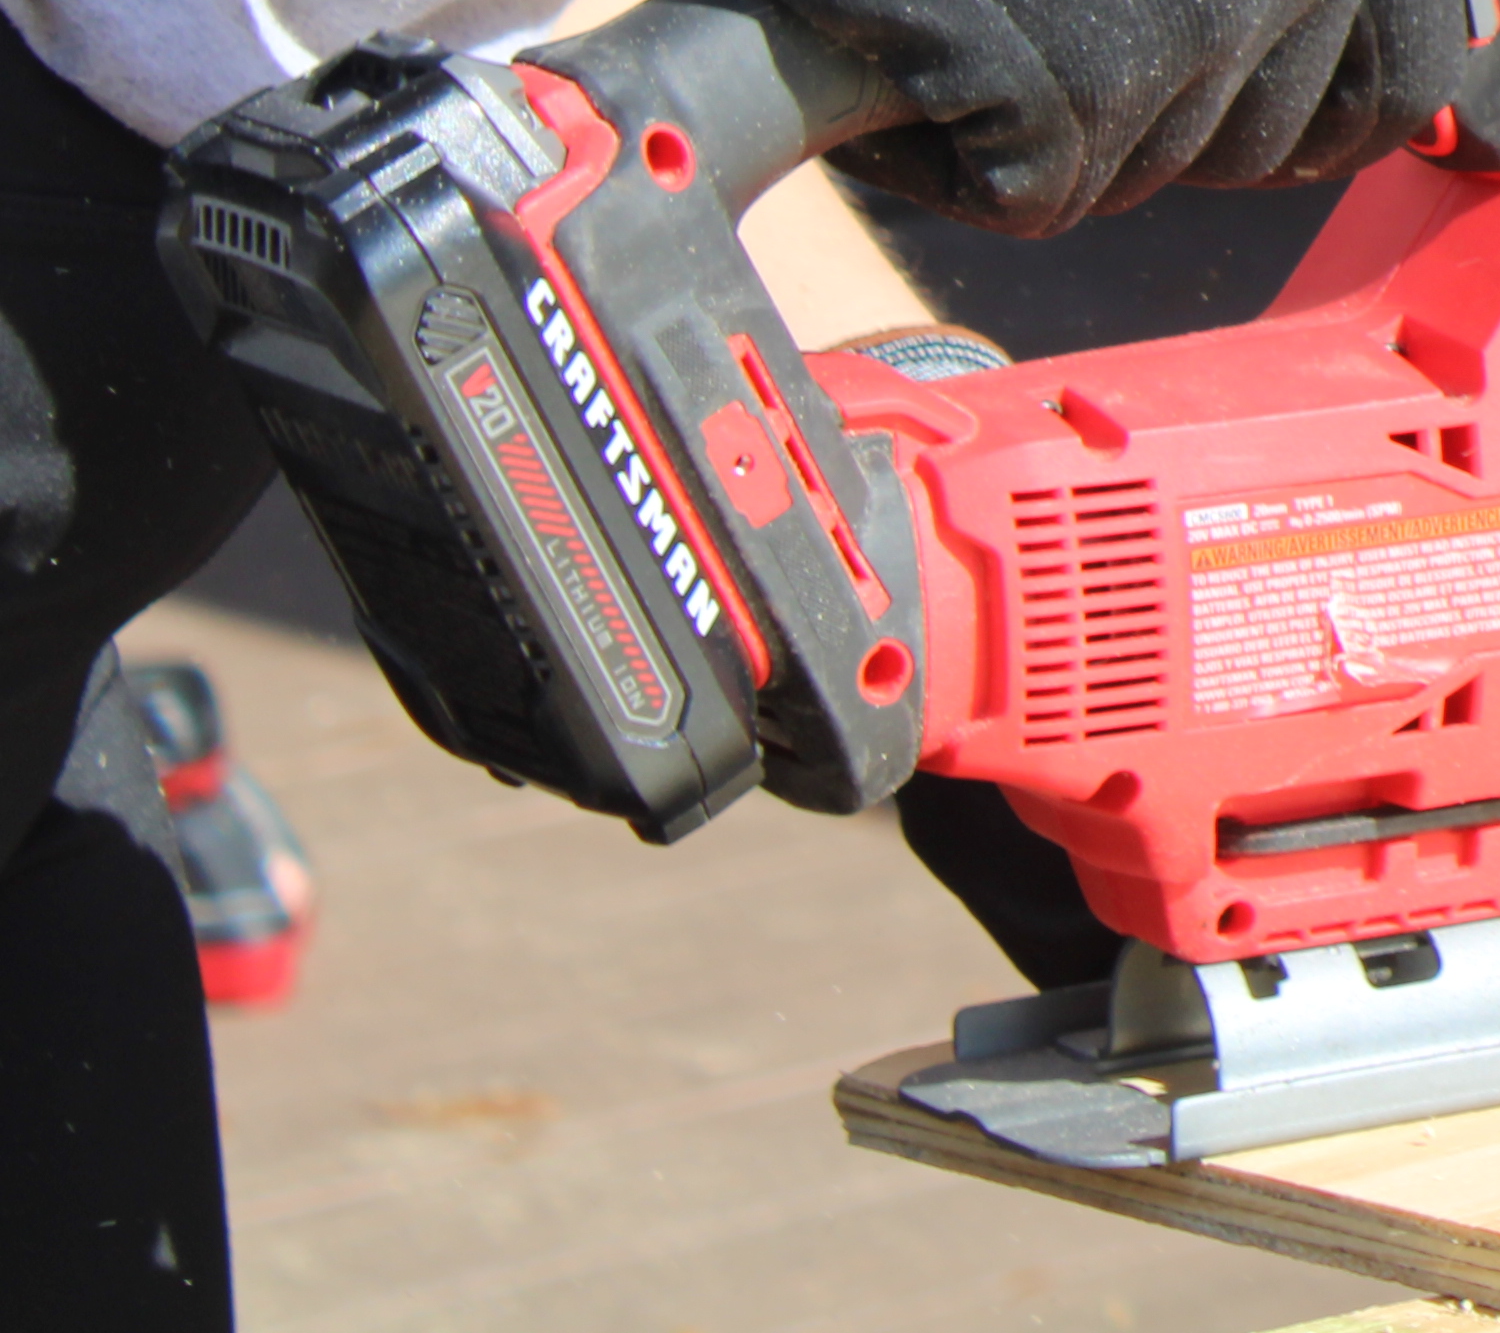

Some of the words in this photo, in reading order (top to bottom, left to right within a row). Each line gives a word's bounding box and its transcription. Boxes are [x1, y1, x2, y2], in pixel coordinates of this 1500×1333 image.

[460, 364, 518, 439] V20
[525, 276, 721, 637] CRAFTSMAN
[1210, 522, 1239, 541] MAX
[1240, 519, 1258, 536] DC
[1366, 499, 1402, 519] (SPM)
[1293, 494, 1324, 513] TYPE
[1250, 563, 1270, 579] THE
[1272, 559, 1297, 576] RISK
[1299, 557, 1312, 572] OF
[1358, 546, 1386, 564] USER
[1387, 542, 1418, 559] MUST
[1421, 538, 1449, 555] READ
[1243, 579, 1263, 595] USE
